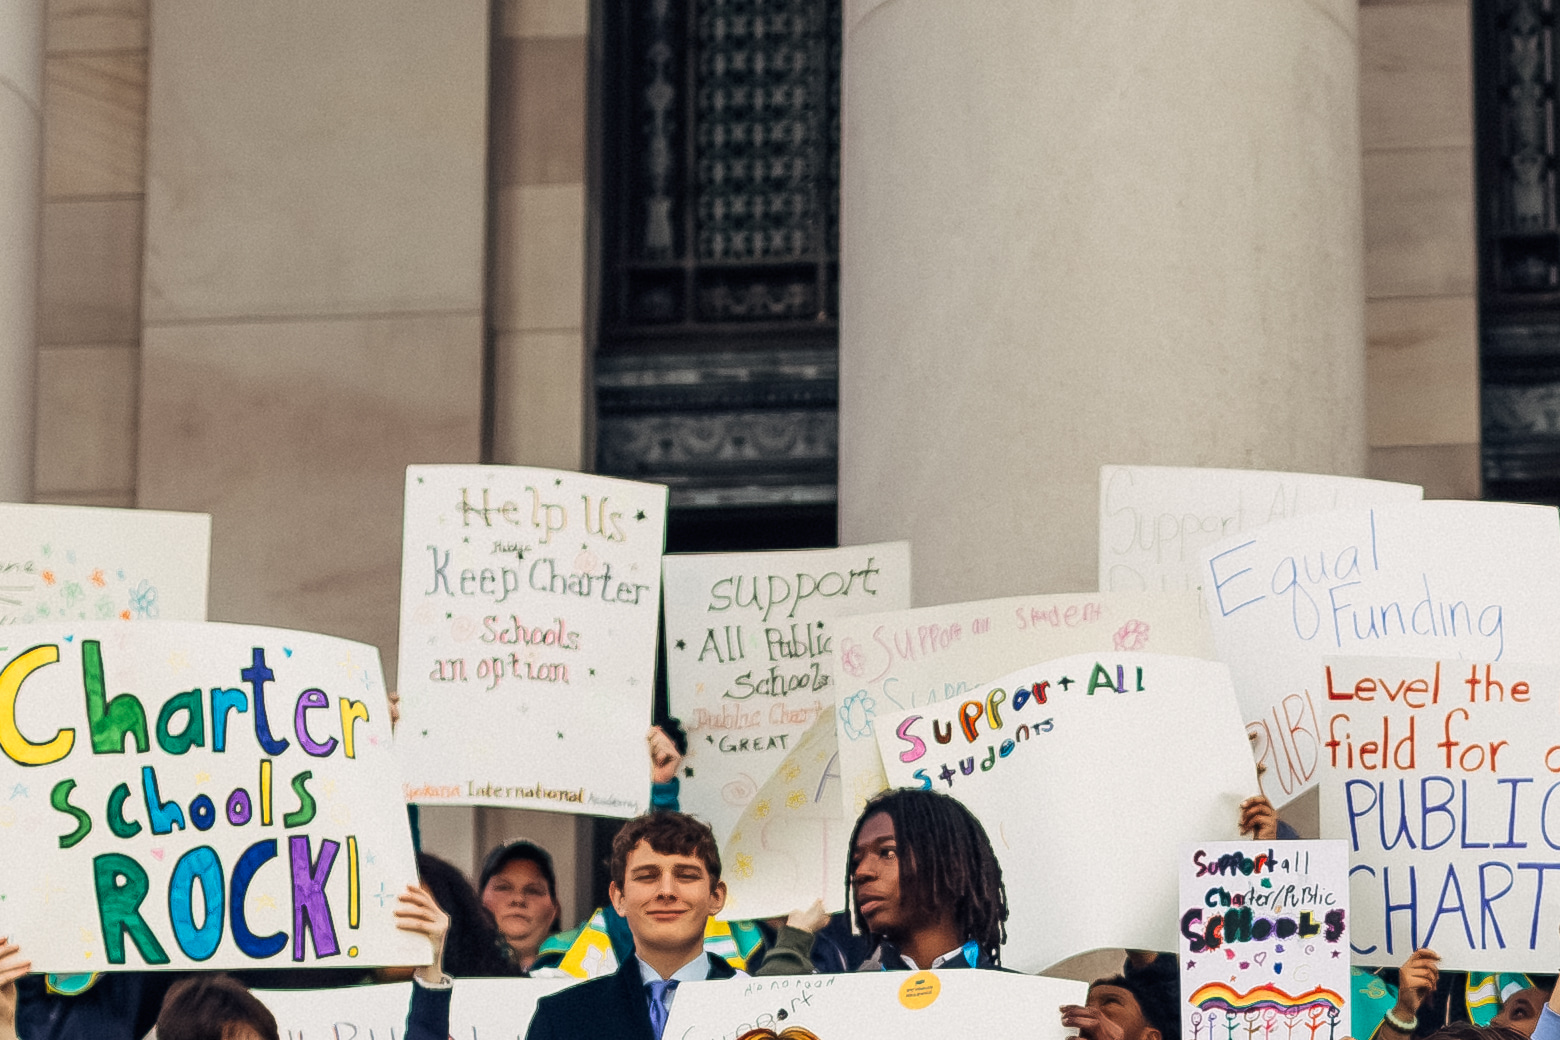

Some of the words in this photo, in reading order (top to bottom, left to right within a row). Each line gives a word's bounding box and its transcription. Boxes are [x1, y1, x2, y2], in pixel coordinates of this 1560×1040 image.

[455, 486, 567, 543] Help
[581, 494, 627, 542] Us
[425, 545, 519, 602] Keep
[529, 558, 650, 605] Charter
[1209, 508, 1379, 640] Equal
[479, 614, 581, 650] Schools
[698, 625, 745, 663] All
[765, 623, 833, 661] Public
[1328, 573, 1504, 661] Funding
[430, 657, 467, 682] an
[477, 653, 569, 686] option
[1325, 660, 1440, 709] Level
[1464, 664, 1531, 703] the
[0, 640, 369, 767] Charter
[1325, 713, 1416, 770] field
[1437, 707, 1509, 772] for
[1281, 851, 1309, 875] all
[92, 834, 361, 965] ROCK!
[1180, 905, 1346, 954] SCHOOLS
